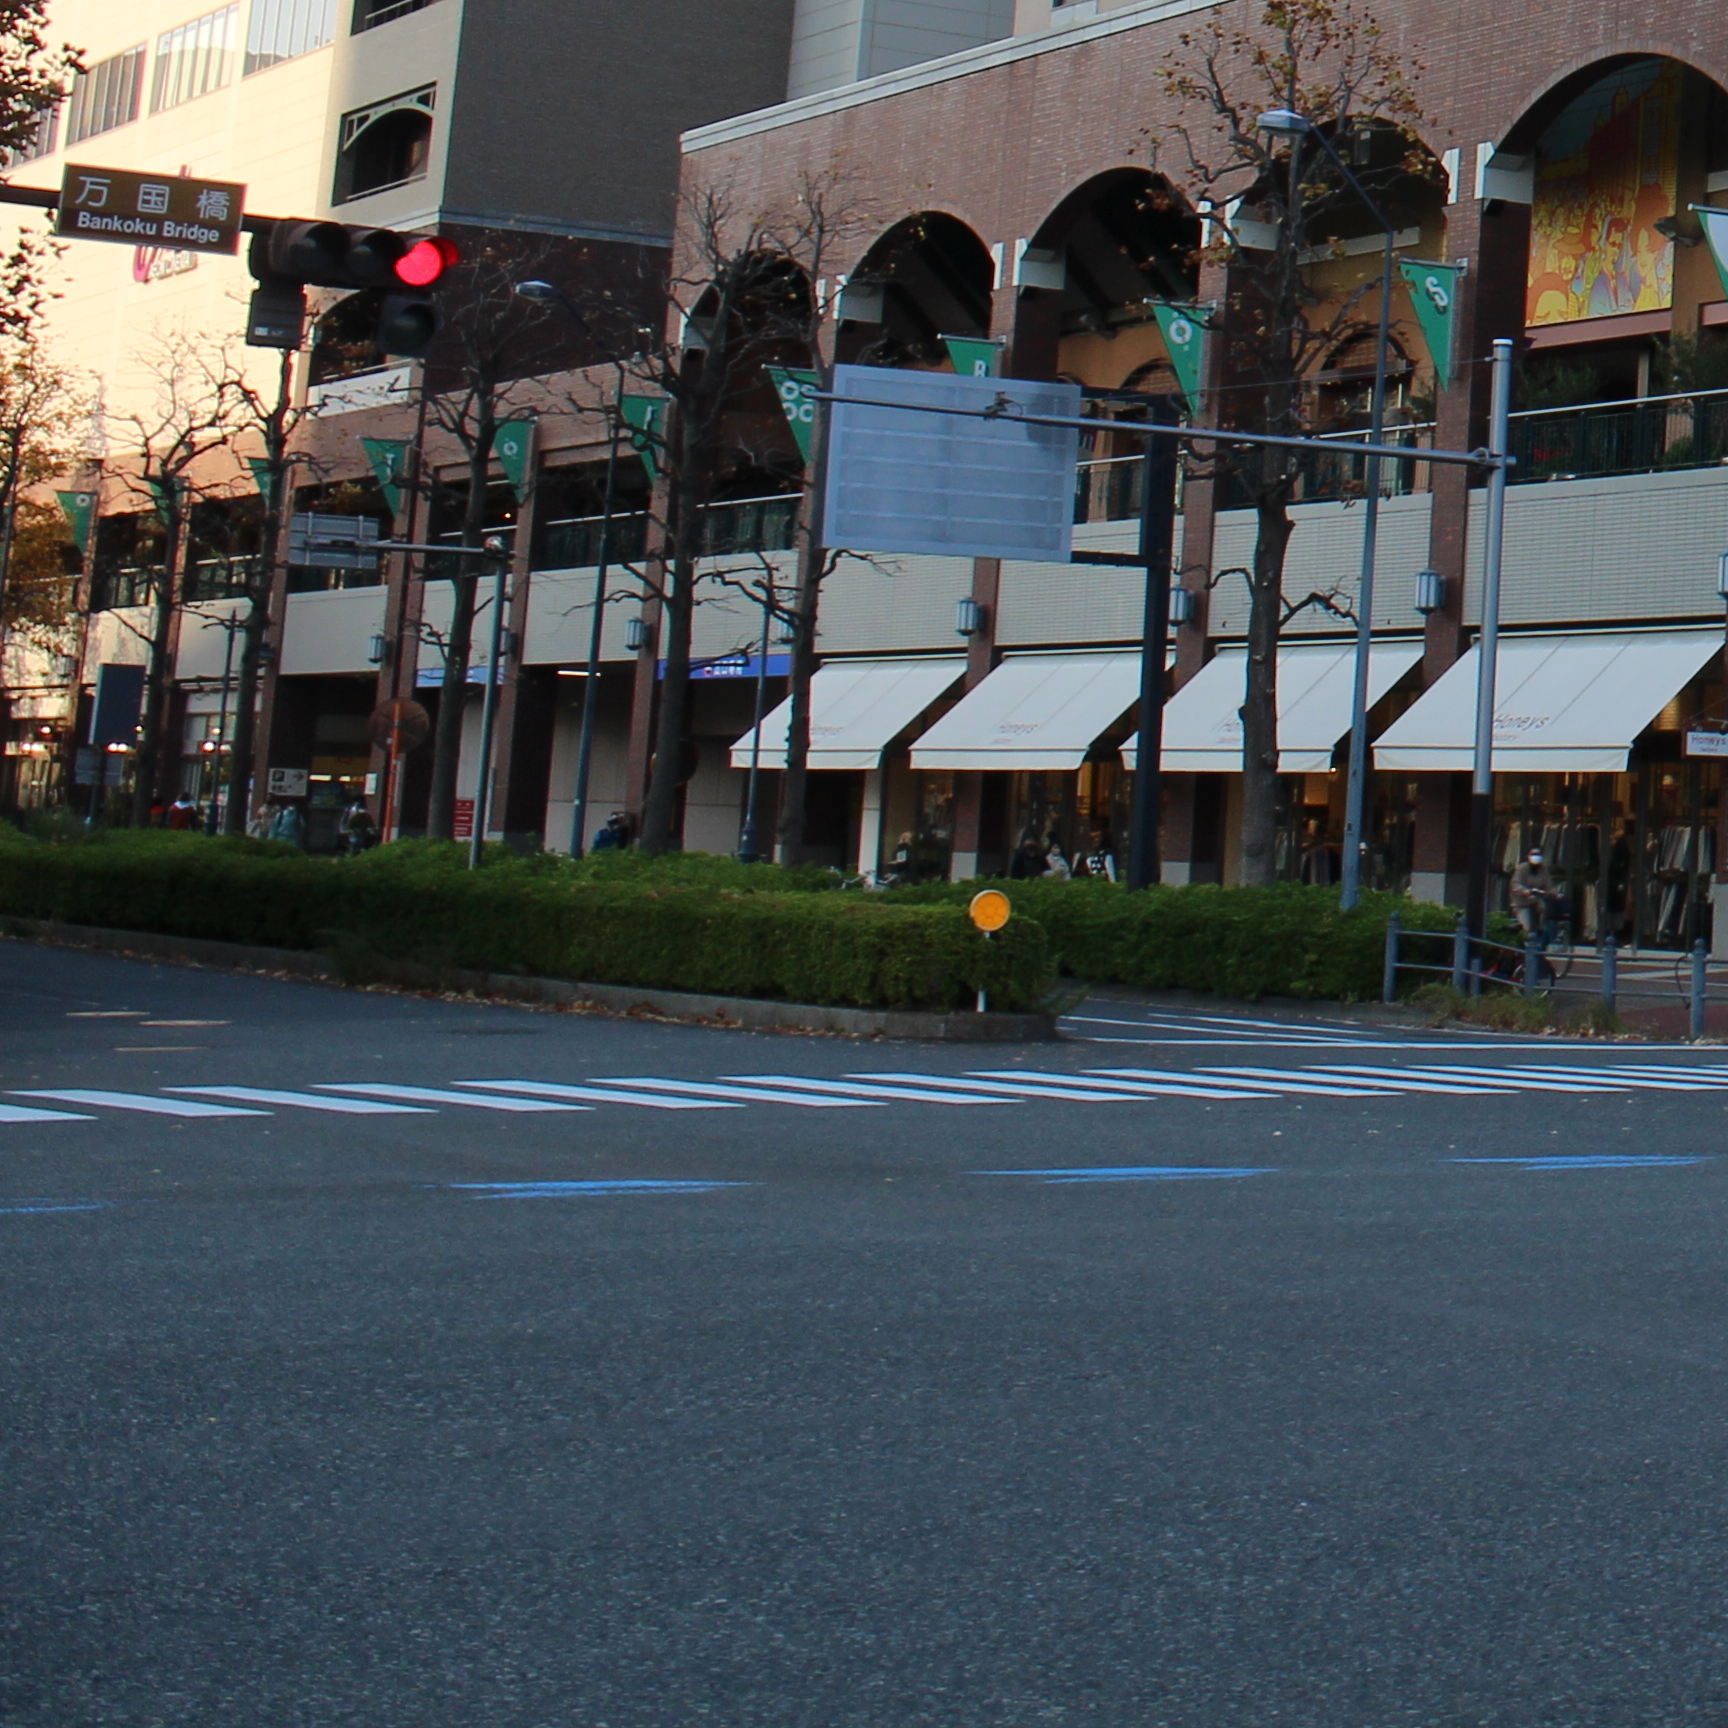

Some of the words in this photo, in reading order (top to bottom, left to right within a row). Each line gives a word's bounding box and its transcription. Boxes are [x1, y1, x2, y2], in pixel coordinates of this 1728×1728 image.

[75, 175, 230, 222] 万国橋
[77, 211, 157, 235] Bankoku
[163, 220, 220, 243] Bridge
[1691, 734, 1726, 746] Honeys
